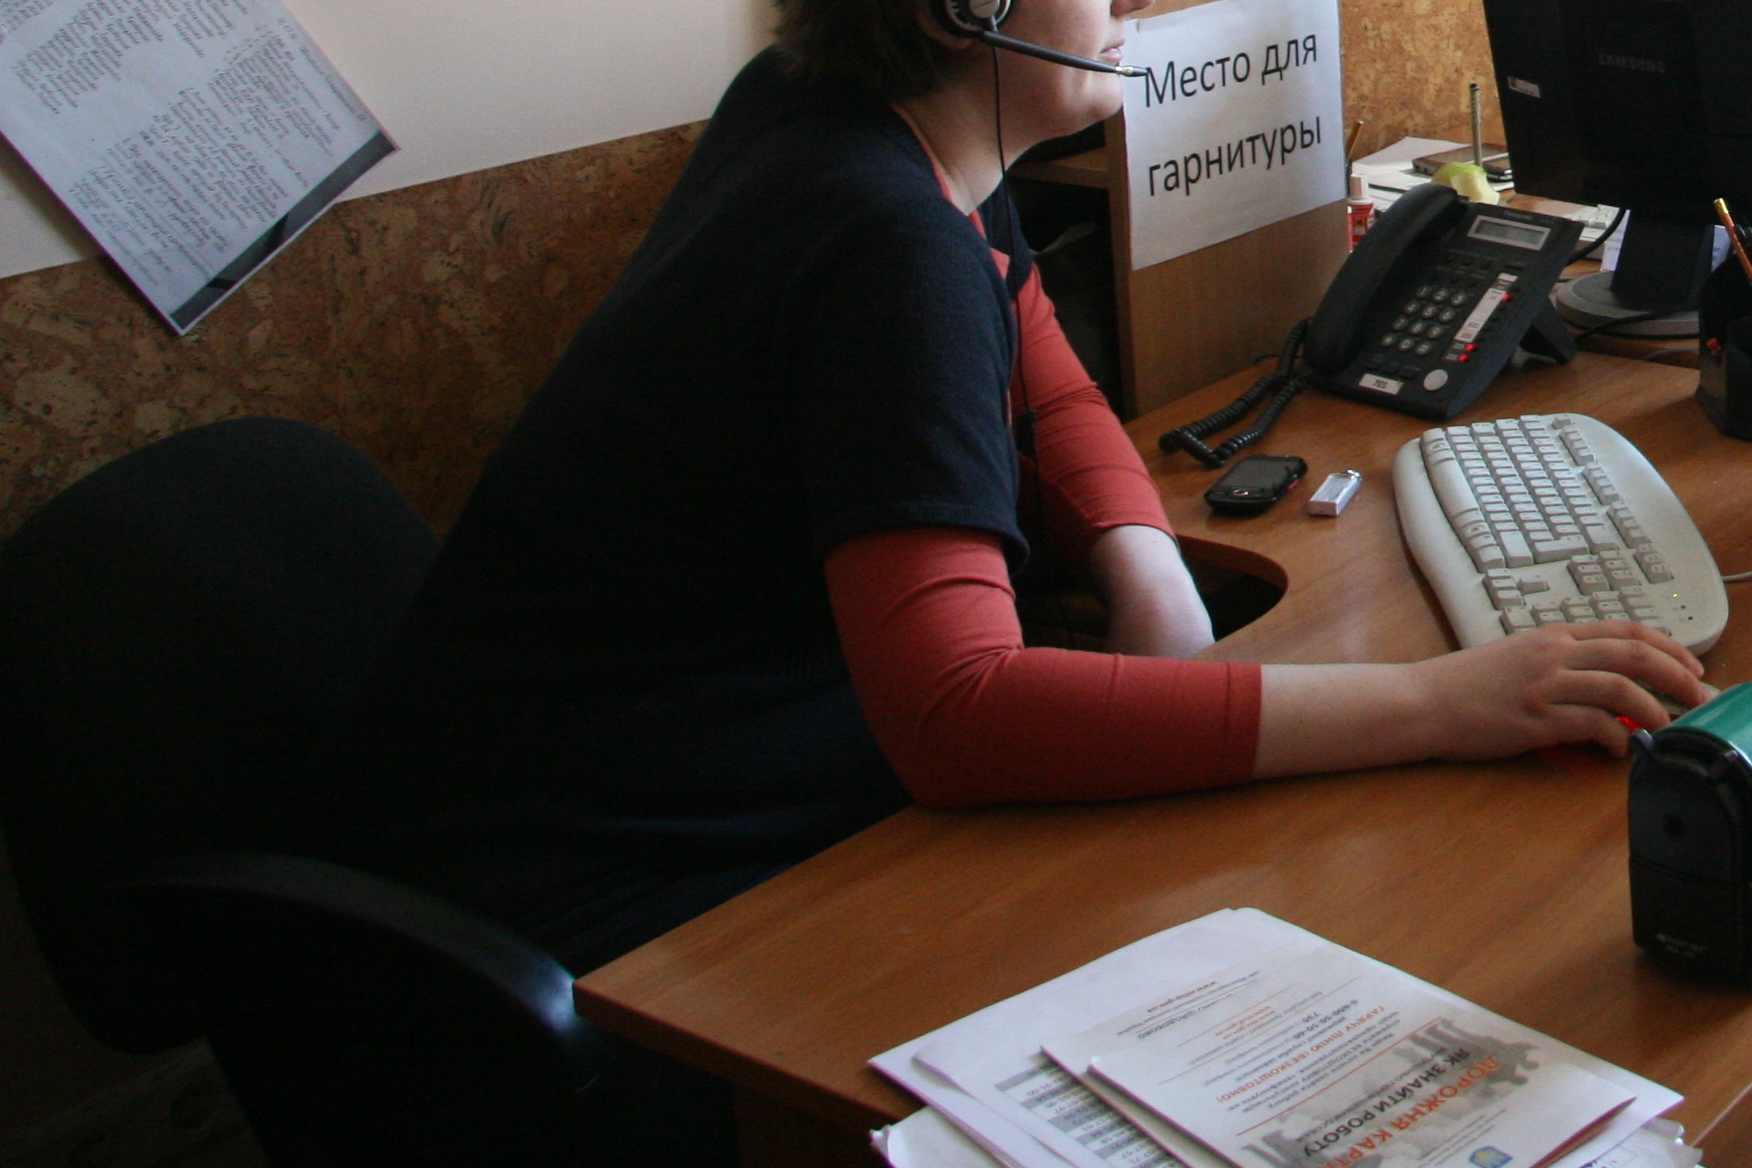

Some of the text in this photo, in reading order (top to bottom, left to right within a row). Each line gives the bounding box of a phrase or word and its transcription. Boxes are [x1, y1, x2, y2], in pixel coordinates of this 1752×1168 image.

[1145, 34, 1317, 108] Место для
[1598, 53, 1666, 75] SAMSUNG
[1149, 116, 1321, 196] гарнитуры
[1311, 1031, 1344, 1051] ЛІНІЮ
[1346, 1006, 1384, 1032] ГАРЯЧУ
[1216, 1052, 1309, 1103] (БЕЗКОШТОВНО)
[1304, 1047, 1470, 1160] ЯК ЗНАЙТИ РОБОТУ
[1391, 1056, 1501, 1132] ДОРОЖНЯ
